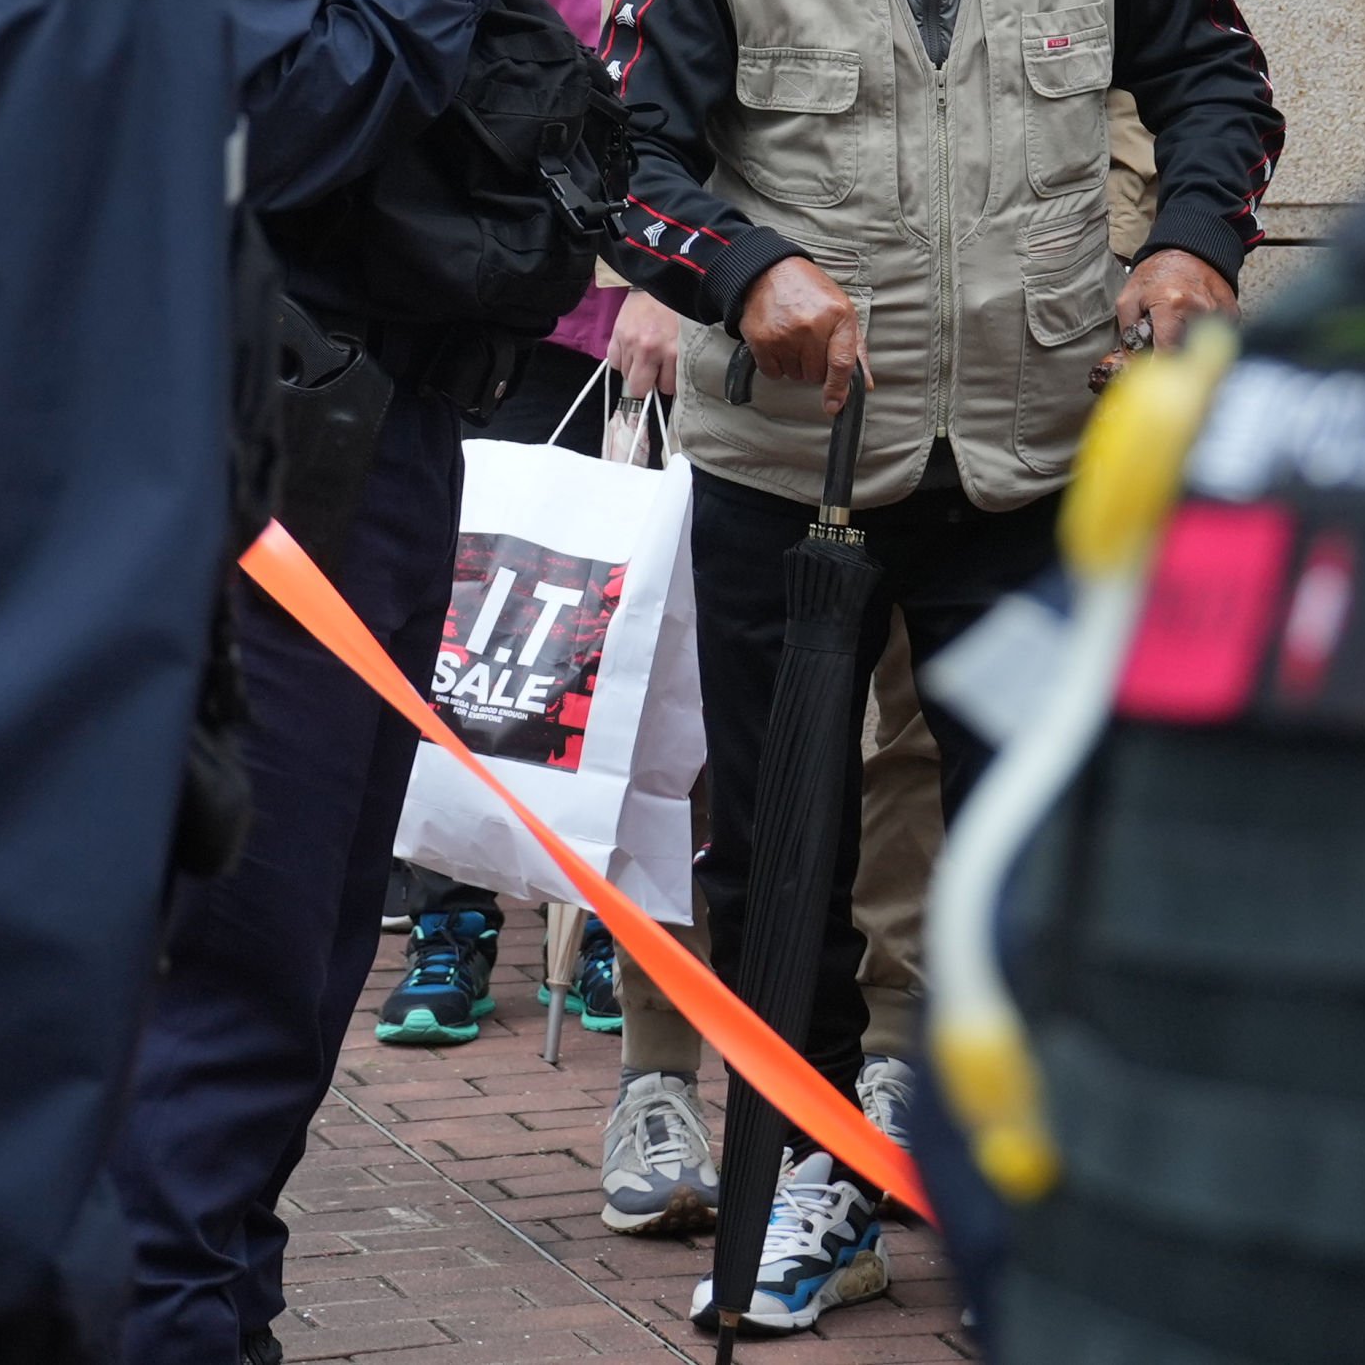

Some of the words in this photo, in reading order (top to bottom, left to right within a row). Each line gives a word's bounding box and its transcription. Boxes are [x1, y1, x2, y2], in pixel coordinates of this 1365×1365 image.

[465, 566, 584, 667] I.T
[431, 651, 556, 714] SALE
[436, 694, 450, 704] ONE
[450, 698, 469, 709] MEGA
[470, 704, 479, 712] IS
[479, 706, 498, 715] GOOD
[498, 708, 528, 721] ENOUGH
[453, 706, 468, 716] FOR
[468, 711, 503, 723] EVERYONE
